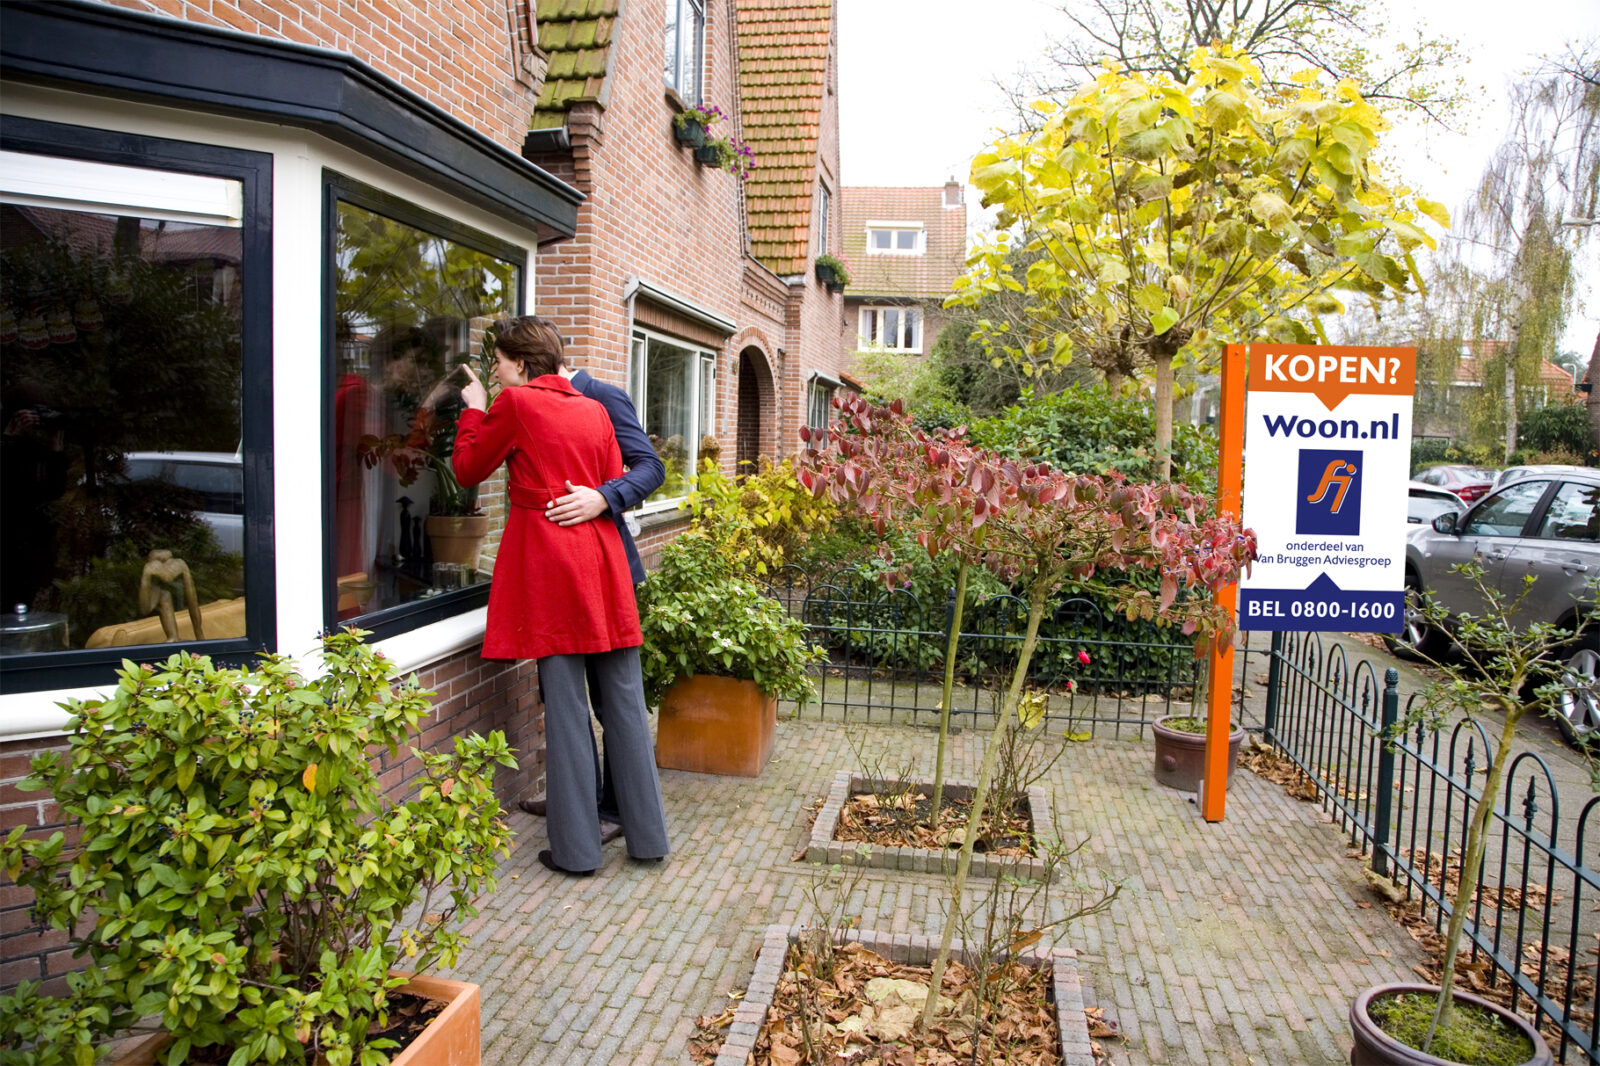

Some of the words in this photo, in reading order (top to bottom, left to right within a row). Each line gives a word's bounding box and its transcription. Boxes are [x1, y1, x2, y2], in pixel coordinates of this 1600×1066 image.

[1264, 353, 1401, 385] KOPEN?
[1262, 413, 1399, 440] Woon.nl
[1286, 541, 1343, 552] onderdeel
[1345, 543, 1364, 552] van
[1277, 554, 1321, 567] Bruggen
[1323, 555, 1391, 568] Adviesgroep
[1248, 600, 1285, 617] BEL
[1291, 601, 1395, 619] 0800-1600
